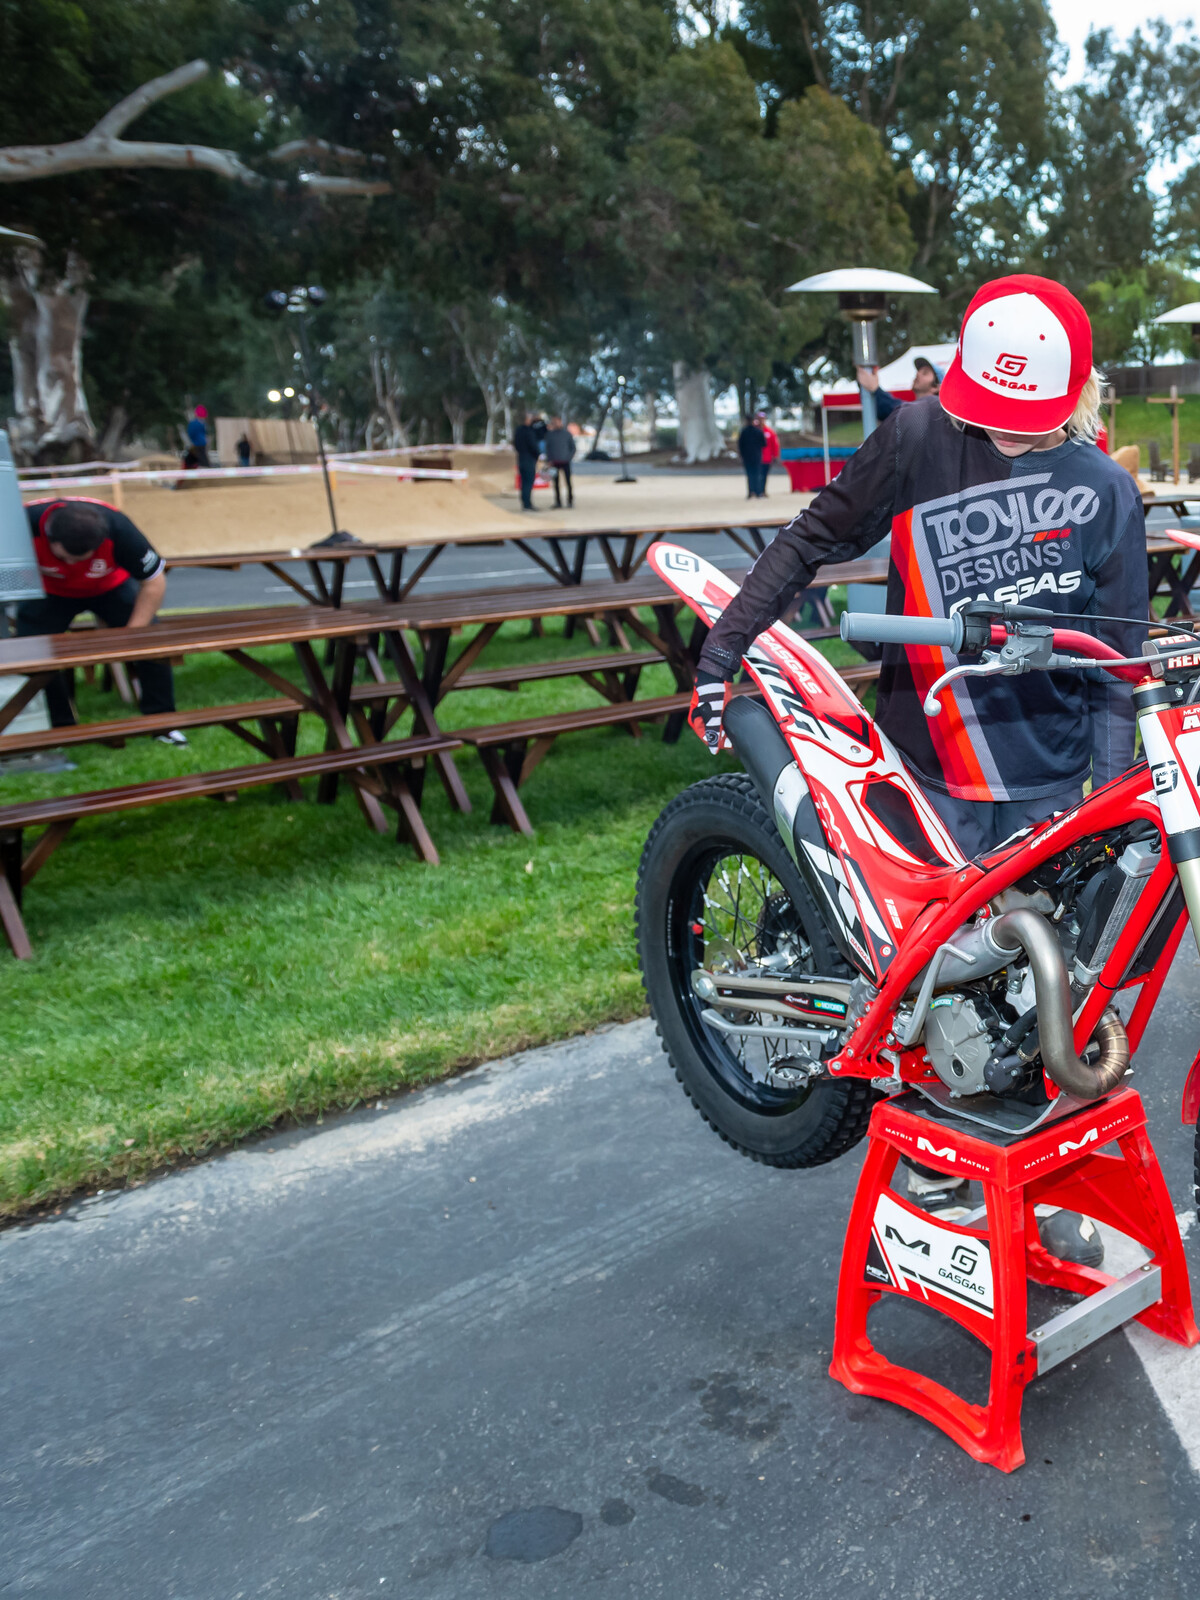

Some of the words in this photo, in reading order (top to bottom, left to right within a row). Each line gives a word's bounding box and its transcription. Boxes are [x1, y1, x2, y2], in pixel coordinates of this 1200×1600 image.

[981, 371, 1038, 391] GASGAS
[941, 542, 1064, 596] DESIGNS
[949, 570, 1082, 615] GSGAS
[758, 632, 823, 695] GASGAS
[1030, 810, 1079, 849] GASGAS
[849, 937, 871, 966] GASGAS
[885, 1127, 913, 1142] MATRIX
[960, 1157, 991, 1172] MATRIX
[1024, 1152, 1054, 1170] MATRIX
[1101, 1115, 1130, 1131] MATRIX
[938, 1267, 986, 1296] GASGAS
